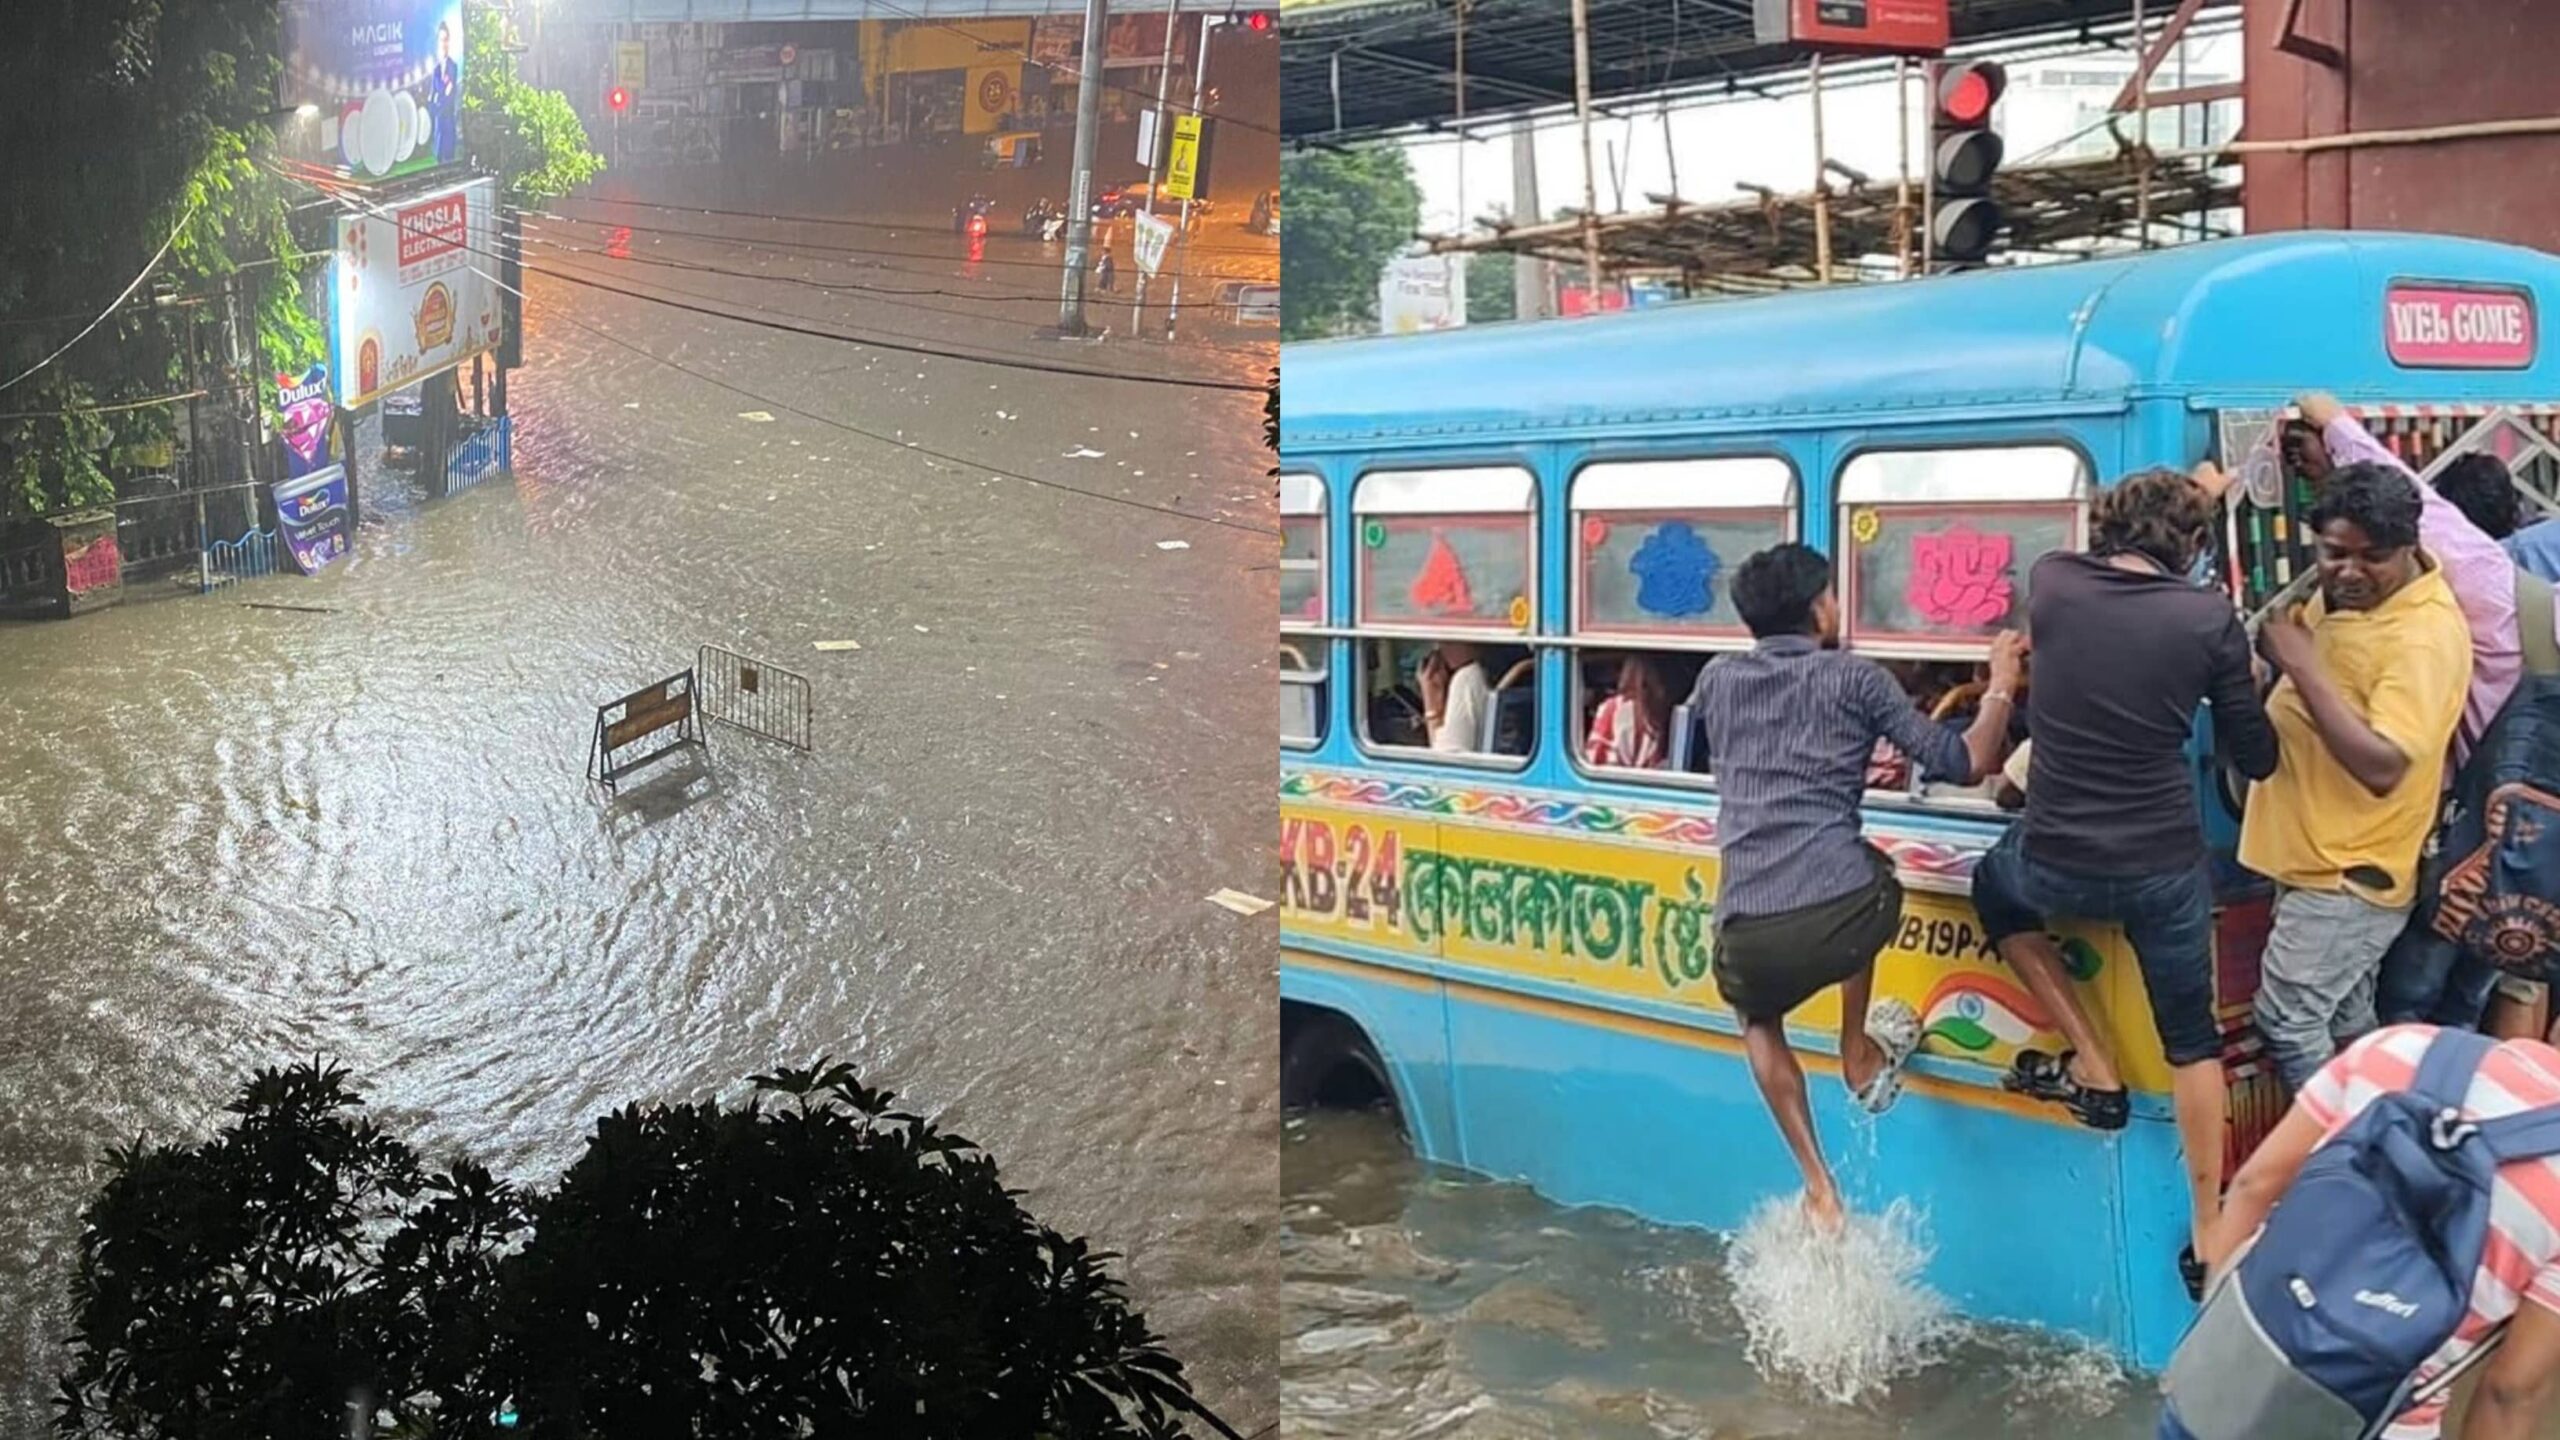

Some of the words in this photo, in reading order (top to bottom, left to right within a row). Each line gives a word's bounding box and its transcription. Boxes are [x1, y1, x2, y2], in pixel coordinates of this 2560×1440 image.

[352, 20, 403, 47] MAGIK
[402, 203, 462, 240] KHOSLA
[279, 382, 322, 407] Dulux
[299, 500, 326, 517] Dulux
